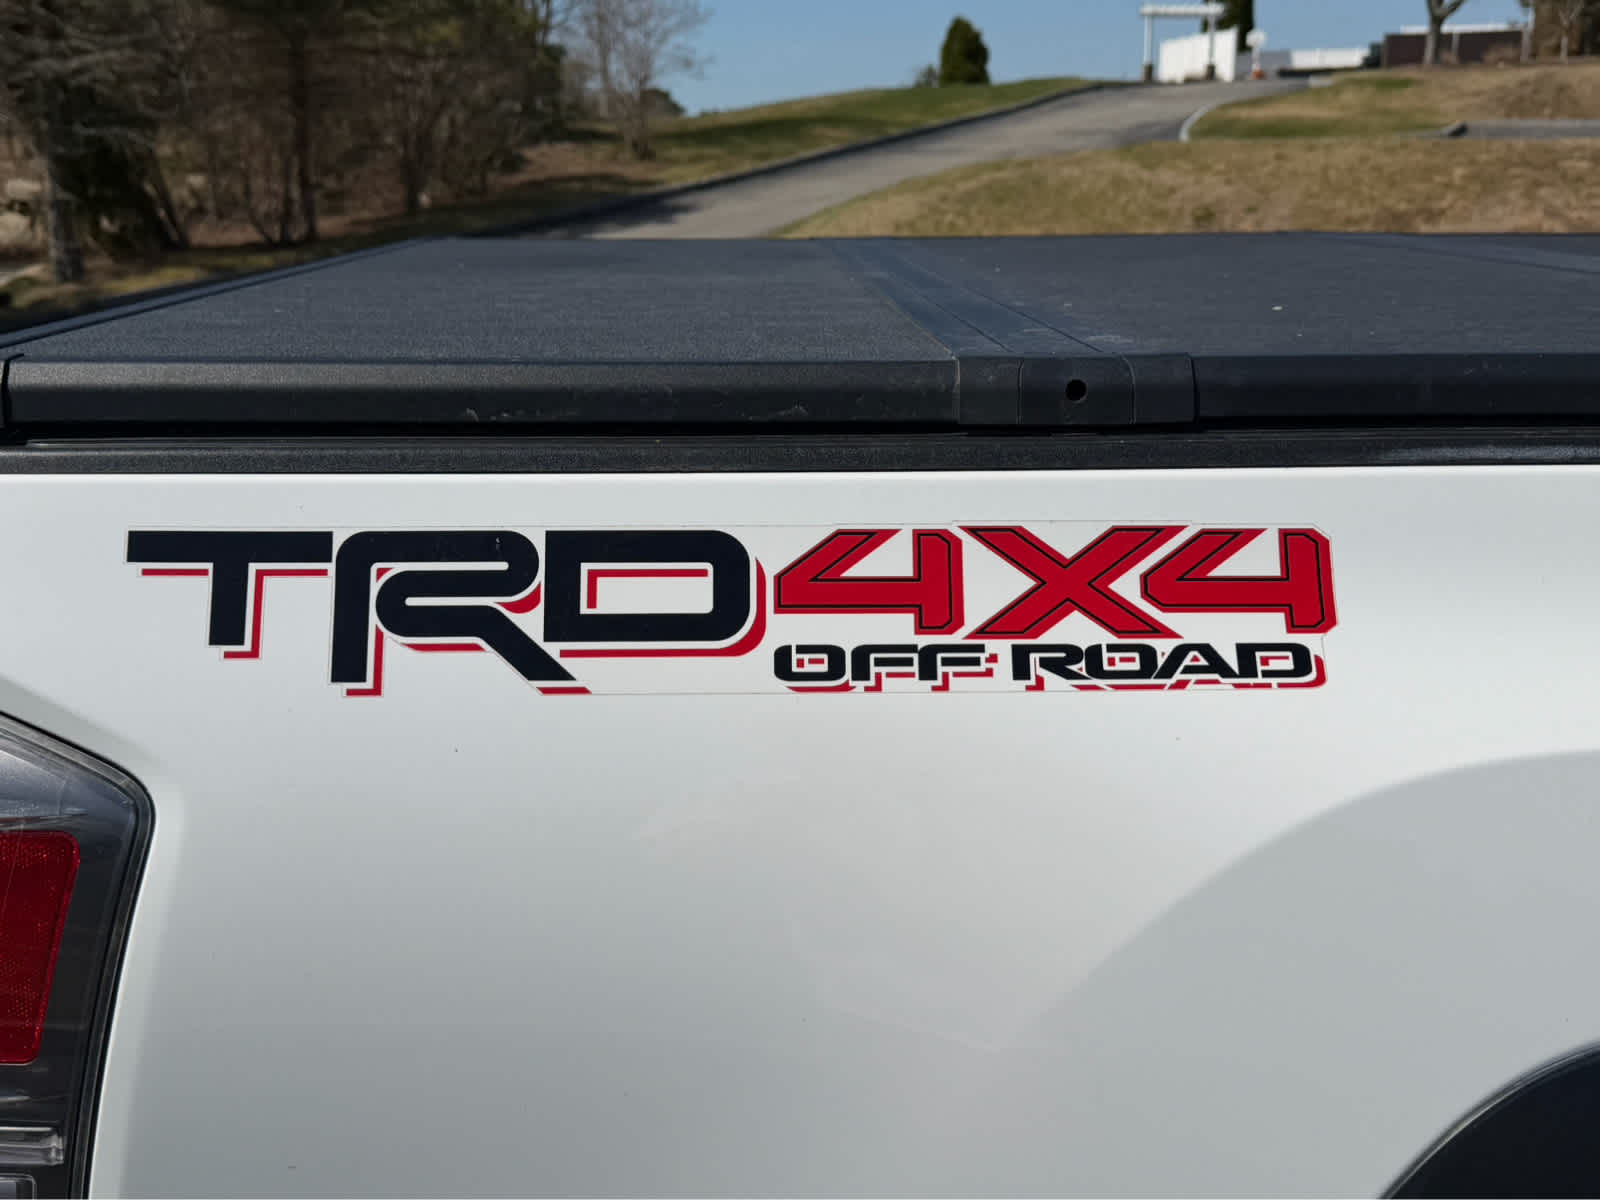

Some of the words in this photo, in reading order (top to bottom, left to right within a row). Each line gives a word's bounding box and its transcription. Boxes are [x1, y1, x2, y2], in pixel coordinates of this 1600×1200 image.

[126, 529, 765, 697] TRD
[773, 525, 1337, 640] 4X4
[773, 643, 997, 691] OFF
[1010, 642, 1326, 690] ROAD
